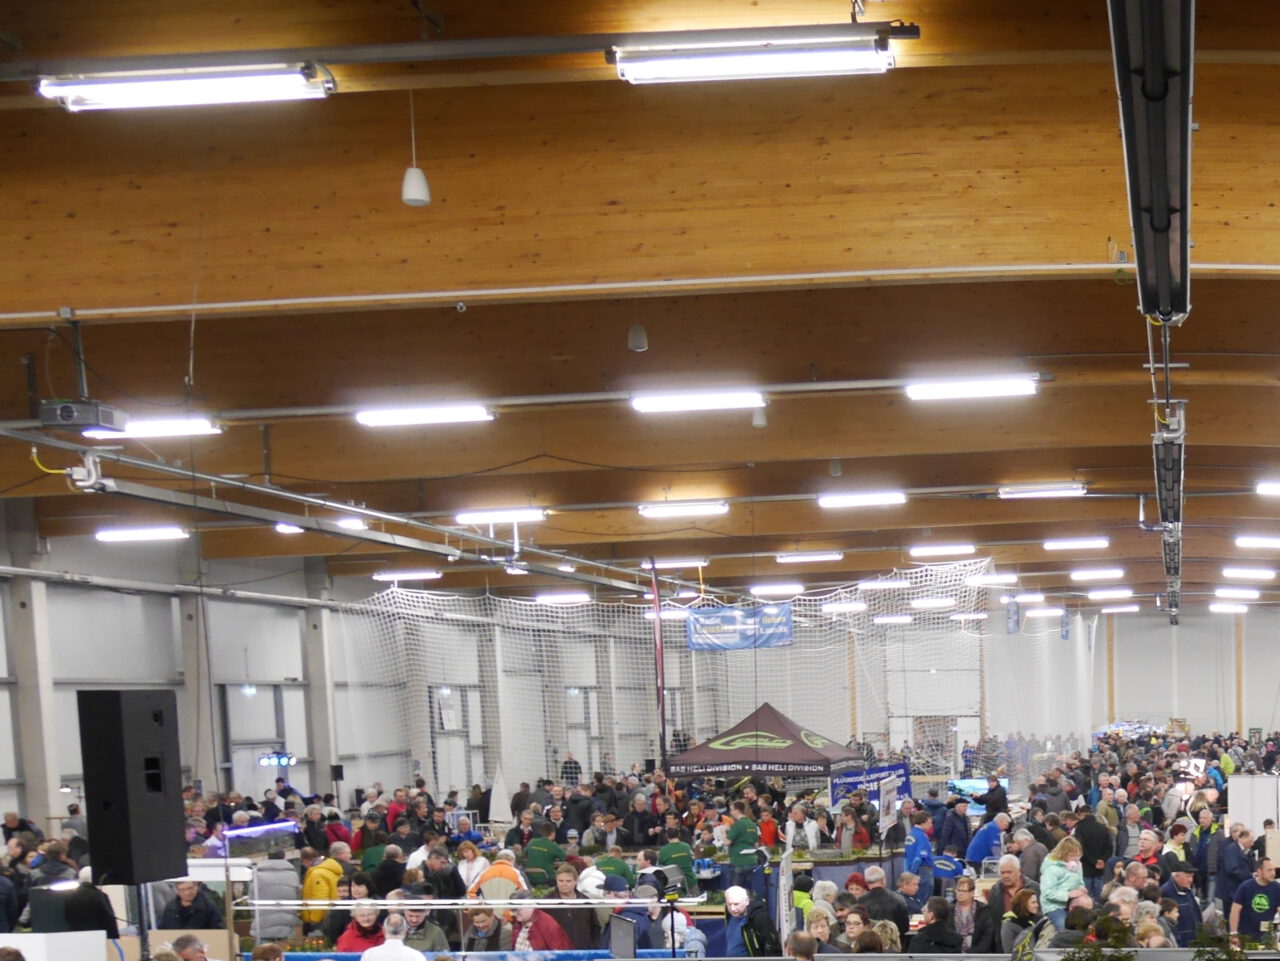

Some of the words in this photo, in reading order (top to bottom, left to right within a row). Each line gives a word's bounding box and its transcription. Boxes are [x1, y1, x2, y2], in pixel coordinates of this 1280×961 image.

[687, 765, 705, 773] HELI
[706, 764, 743, 772] DIVISION
[788, 764, 824, 772] DIVISION
